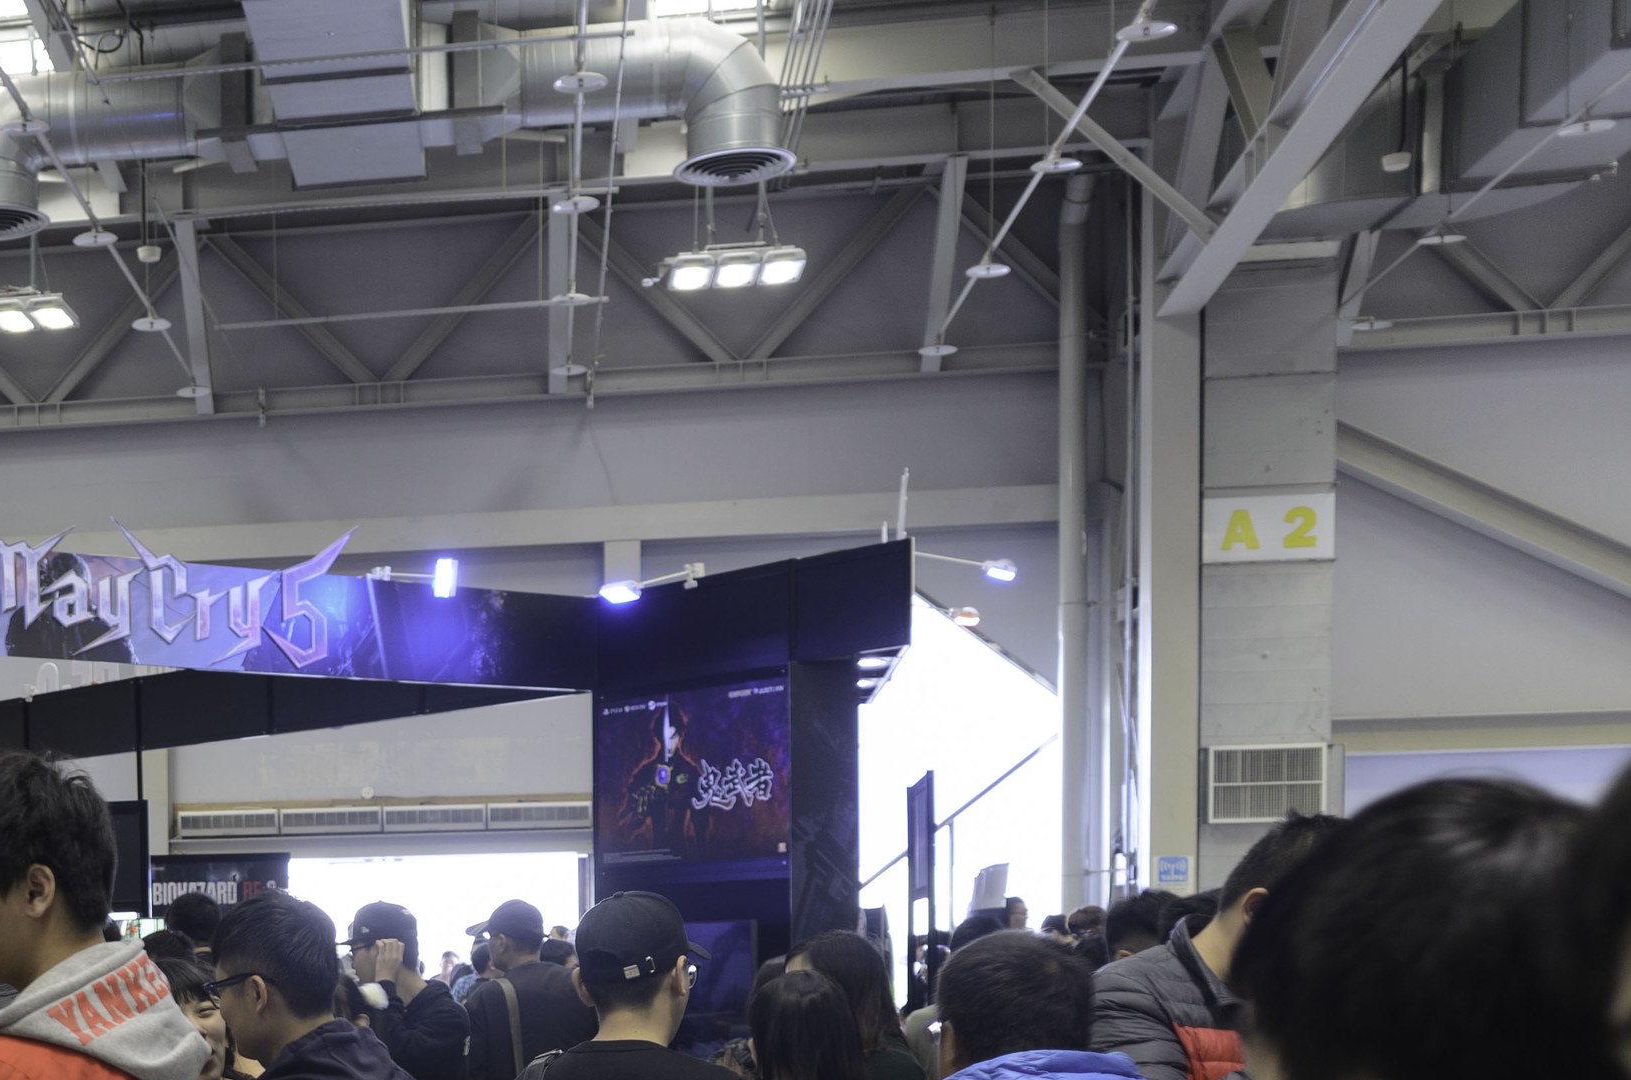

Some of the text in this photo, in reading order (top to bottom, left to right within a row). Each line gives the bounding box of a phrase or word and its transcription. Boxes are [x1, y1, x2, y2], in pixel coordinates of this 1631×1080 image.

[110, 515, 282, 667] Cry
[261, 525, 359, 669] 5
[45, 953, 169, 1046] YANKE
